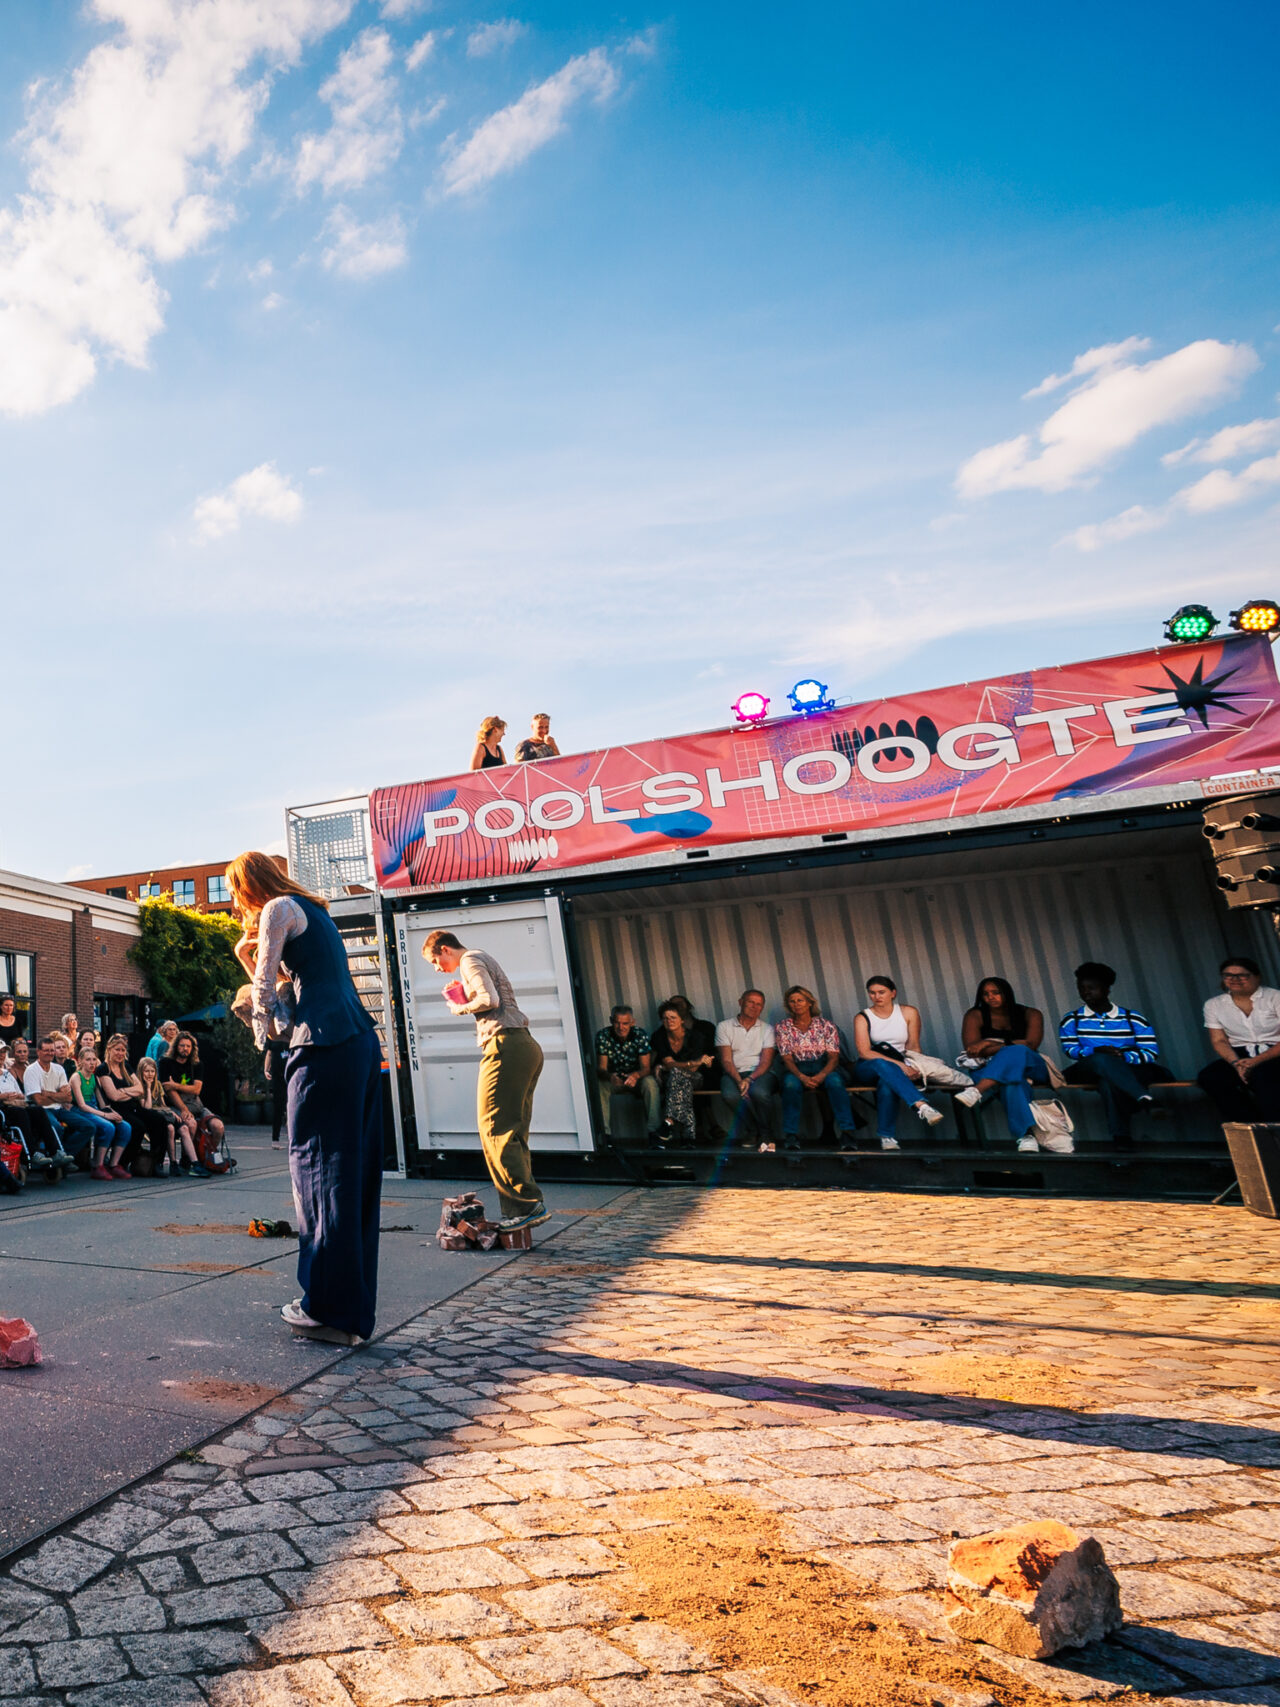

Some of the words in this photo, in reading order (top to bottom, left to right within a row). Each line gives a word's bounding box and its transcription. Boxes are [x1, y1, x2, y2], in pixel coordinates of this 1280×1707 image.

[423, 691, 1194, 848] POOLSHOOGTE
[398, 929, 412, 1004] BRUINS
[406, 1007, 419, 1072] LAREN
